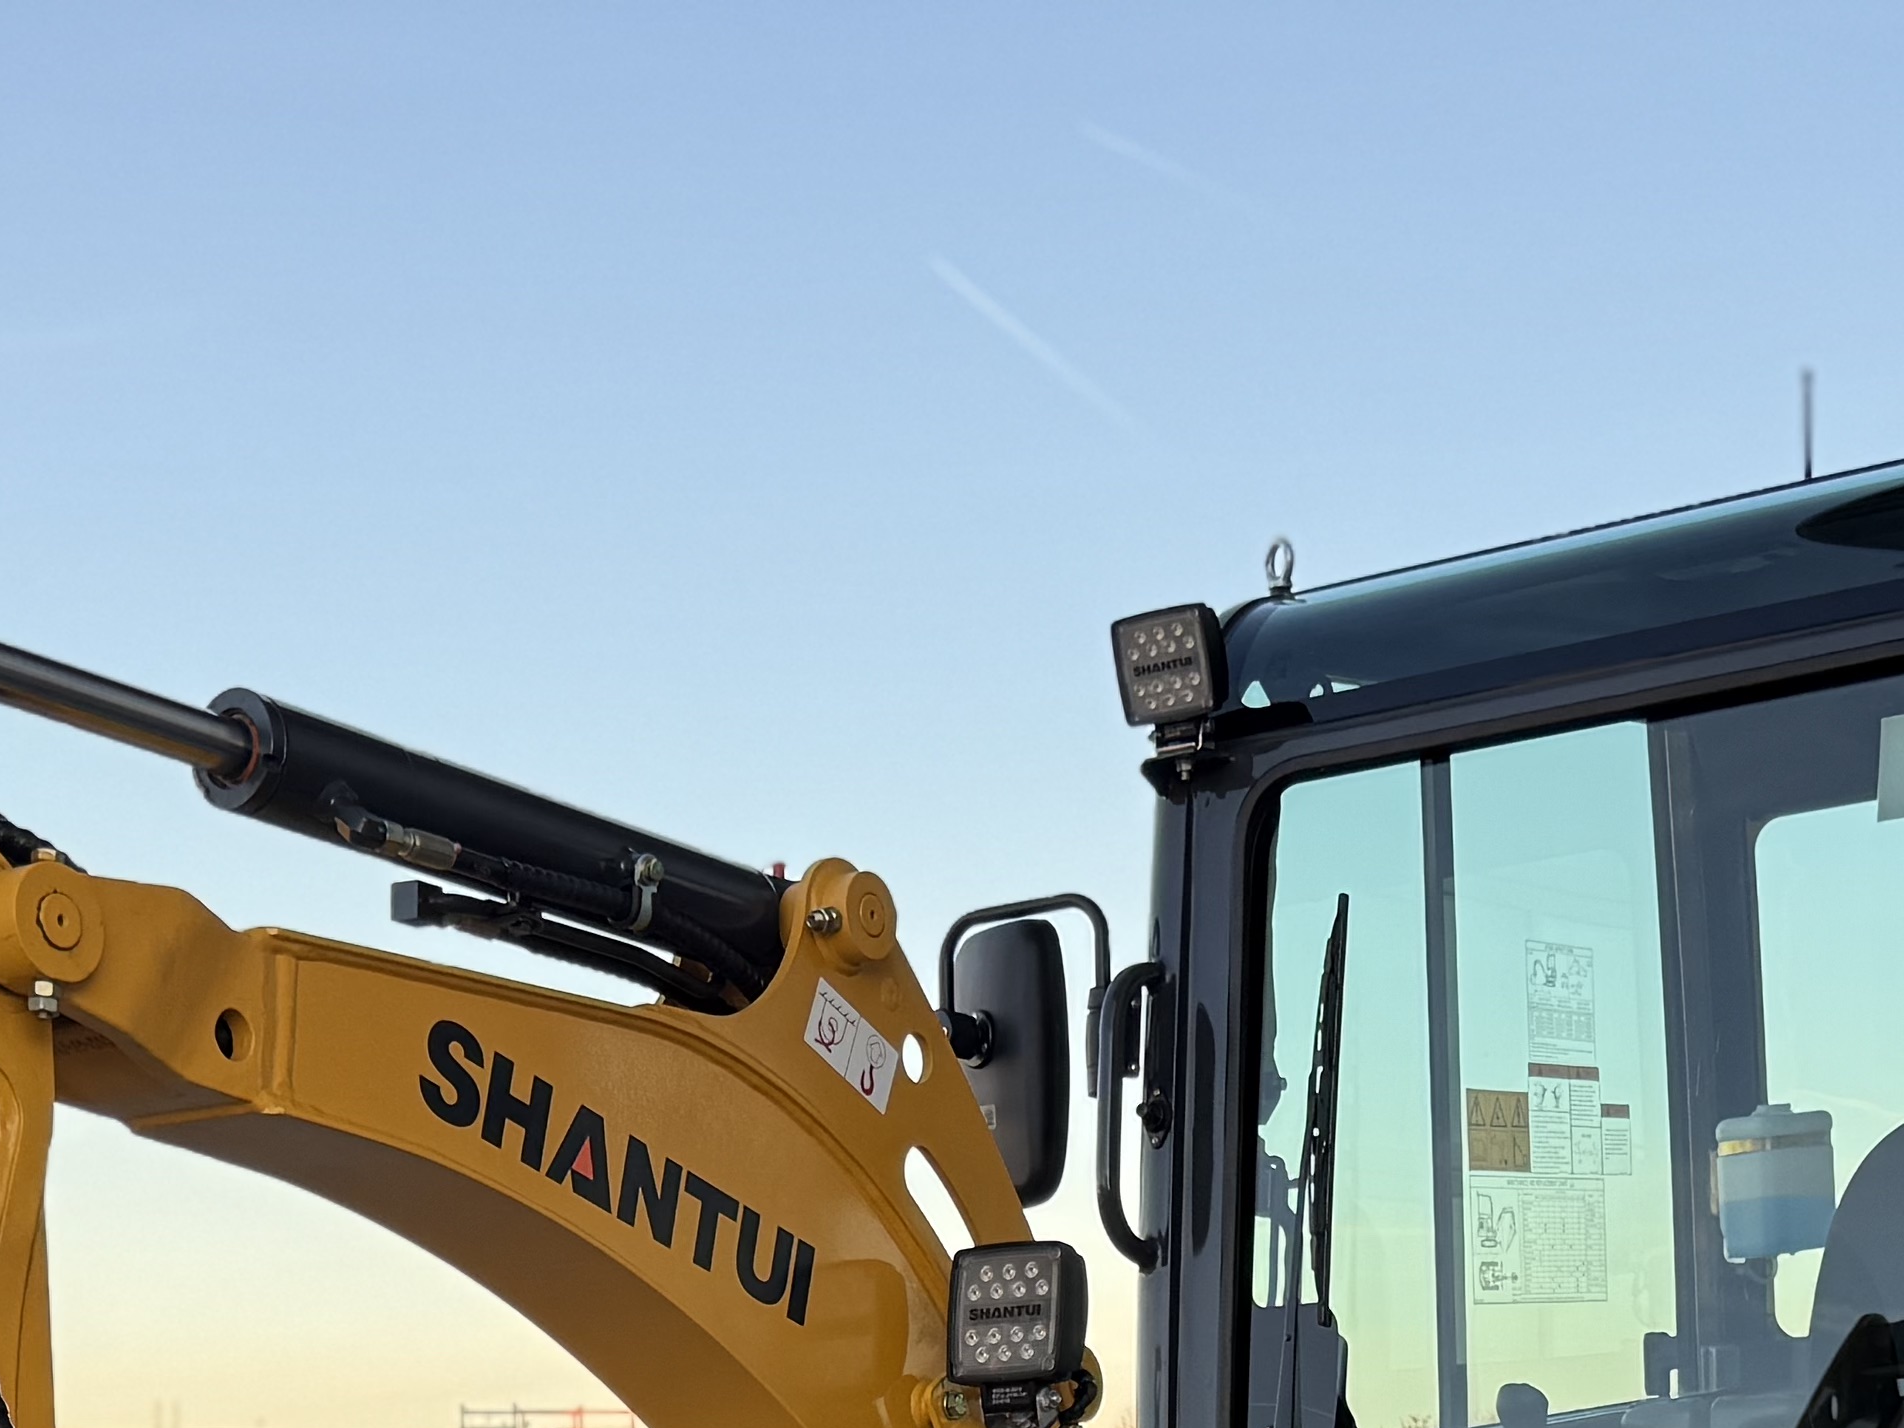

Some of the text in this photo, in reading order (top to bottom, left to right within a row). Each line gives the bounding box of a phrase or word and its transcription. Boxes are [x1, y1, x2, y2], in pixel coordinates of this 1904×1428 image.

[1132, 656, 1193, 677] SHANTUI
[418, 1019, 816, 1327] SHANTUI
[968, 1304, 1042, 1321] SHANTUI
